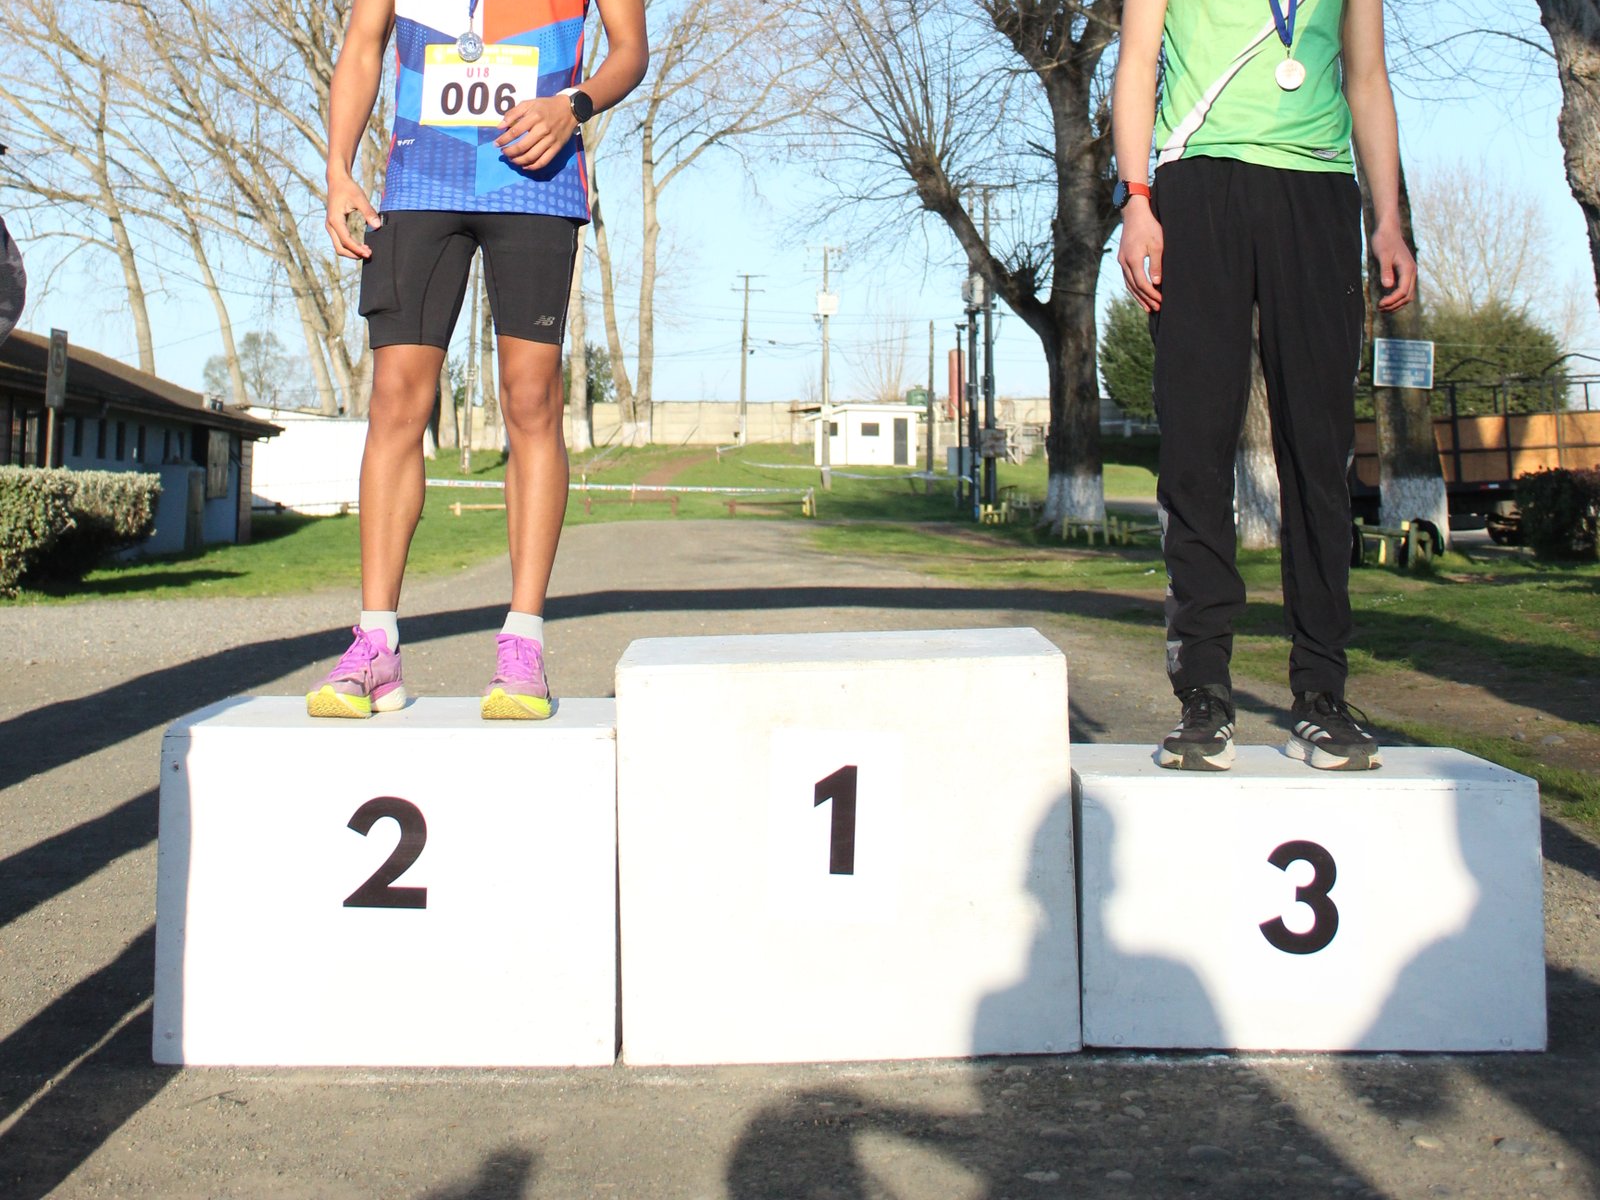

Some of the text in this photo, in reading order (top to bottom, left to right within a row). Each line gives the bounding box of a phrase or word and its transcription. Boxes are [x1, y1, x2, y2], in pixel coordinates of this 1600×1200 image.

[441, 82, 517, 116] 006
[466, 67, 490, 78] U18
[343, 796, 427, 910] 2
[814, 765, 858, 876] 1
[1259, 840, 1339, 955] 3
